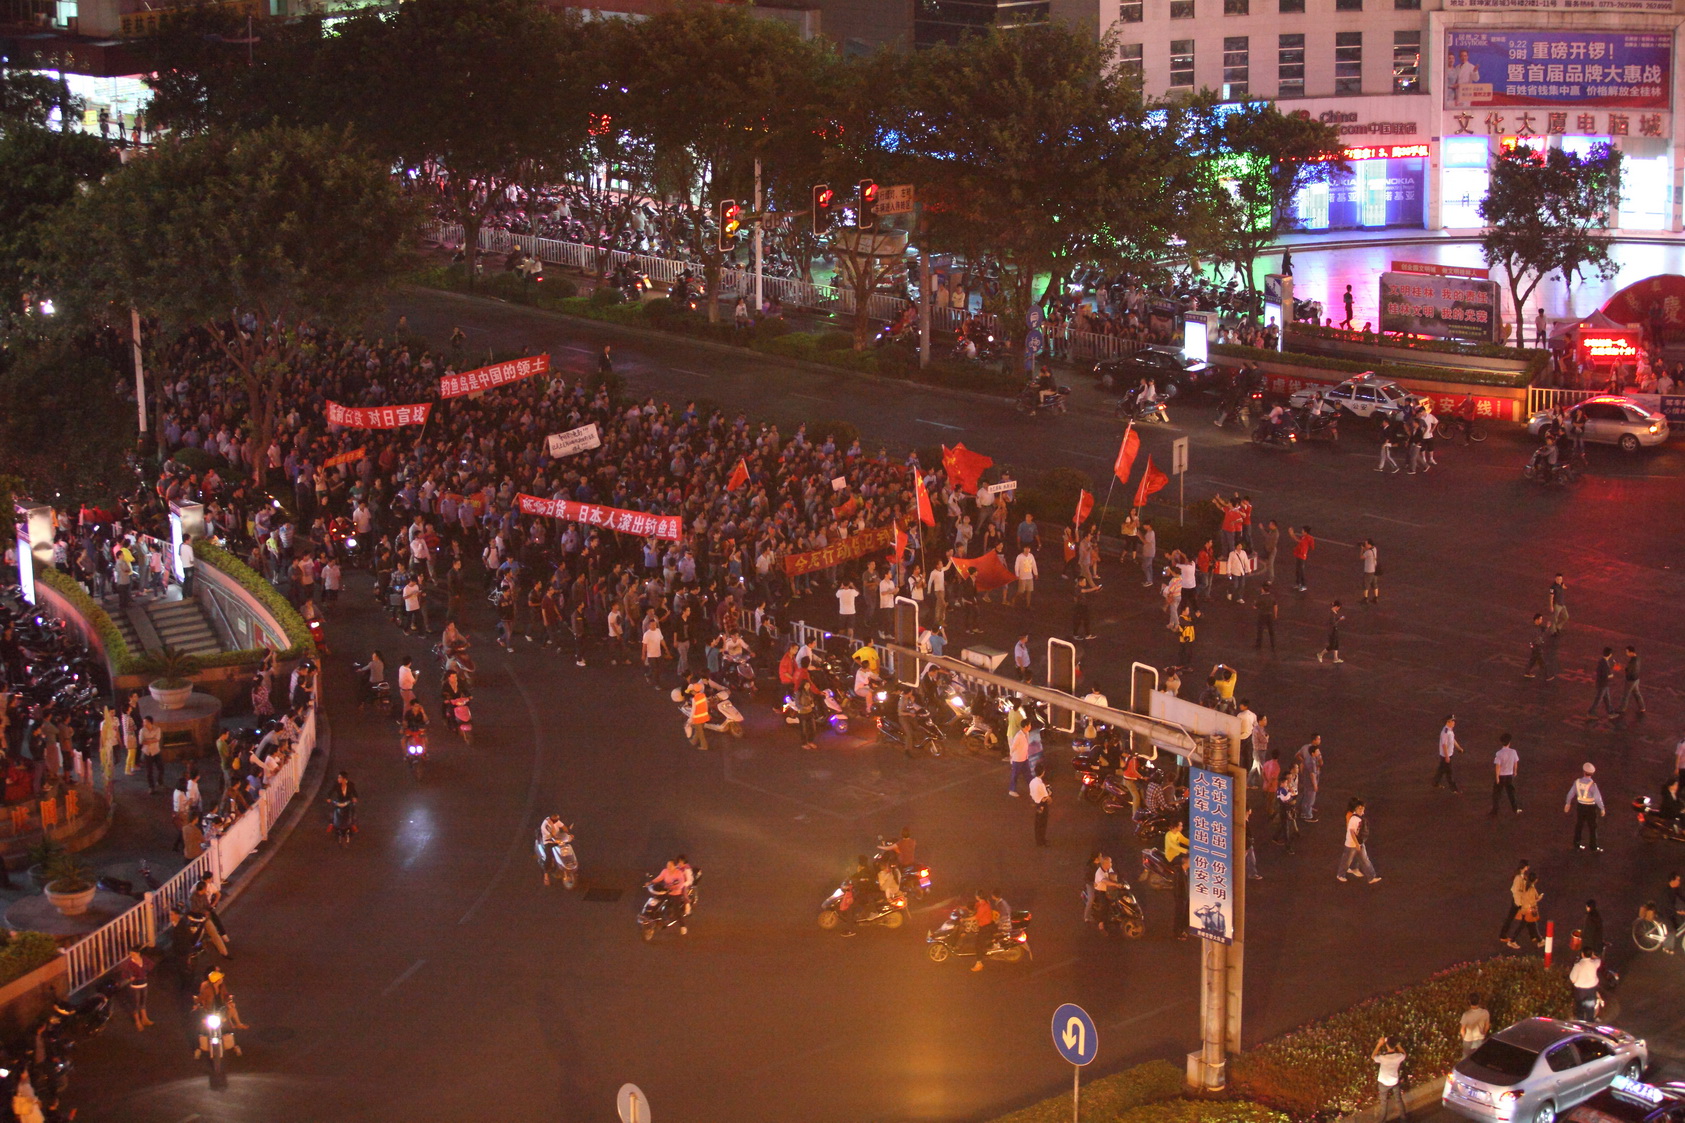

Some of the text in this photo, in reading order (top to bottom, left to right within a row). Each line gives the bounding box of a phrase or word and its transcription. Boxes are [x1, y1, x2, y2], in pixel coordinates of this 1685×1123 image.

[1508, 40, 1527, 48] 9.22
[1508, 49, 1527, 60] 9时
[1506, 64, 1662, 84] 暨首届品牌大惠战
[1506, 85, 1662, 97] 百姓省钱集中赢 价格解放全桂林
[1319, 110, 1358, 123] China
[1453, 111, 1662, 137] 文化大厦电脑城
[1367, 122, 1417, 135] 中国联通
[1388, 284, 1489, 304] 文明桂林 我的责任
[1387, 302, 1489, 323] 桂林文明 我的光荣
[441, 357, 545, 396] 钓鱼岛是中国的领土
[367, 406, 426, 427] 对日宣战
[1352, 402, 1368, 411] 公安
[1193, 772, 1210, 896] 人让车 让出一份安全
[1211, 776, 1228, 901] 车让人 让出一份文明
